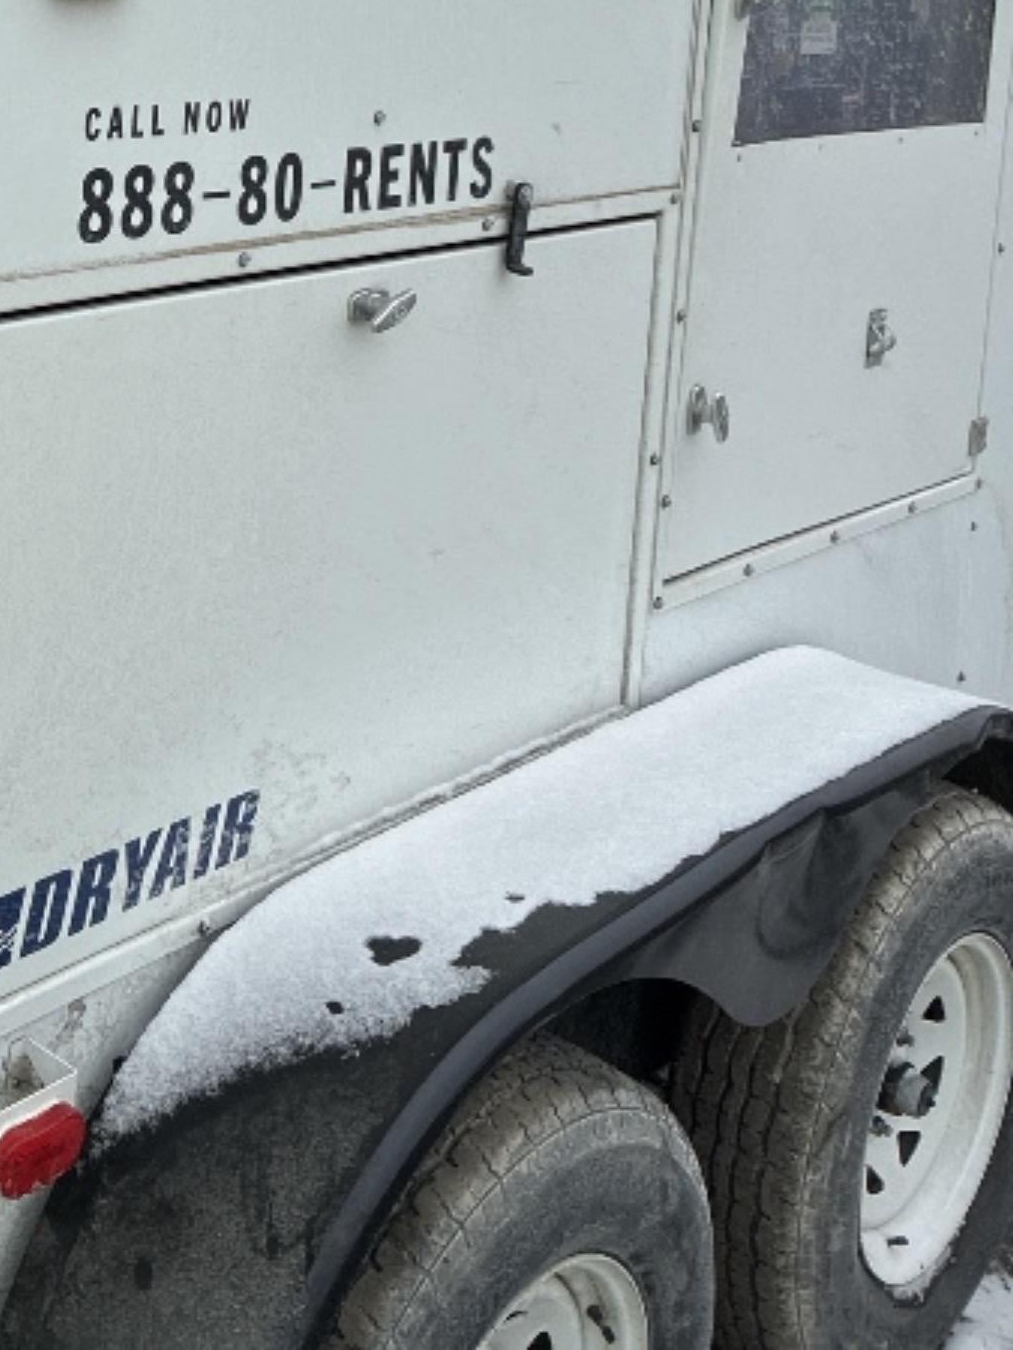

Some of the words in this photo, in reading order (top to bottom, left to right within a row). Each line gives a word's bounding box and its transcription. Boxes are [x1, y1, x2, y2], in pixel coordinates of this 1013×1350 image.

[85, 105, 165, 142] CALL
[183, 99, 251, 136] NOW
[78, 136, 496, 243] 888-80-RENTS
[20, 789, 260, 958] DRYAIR
